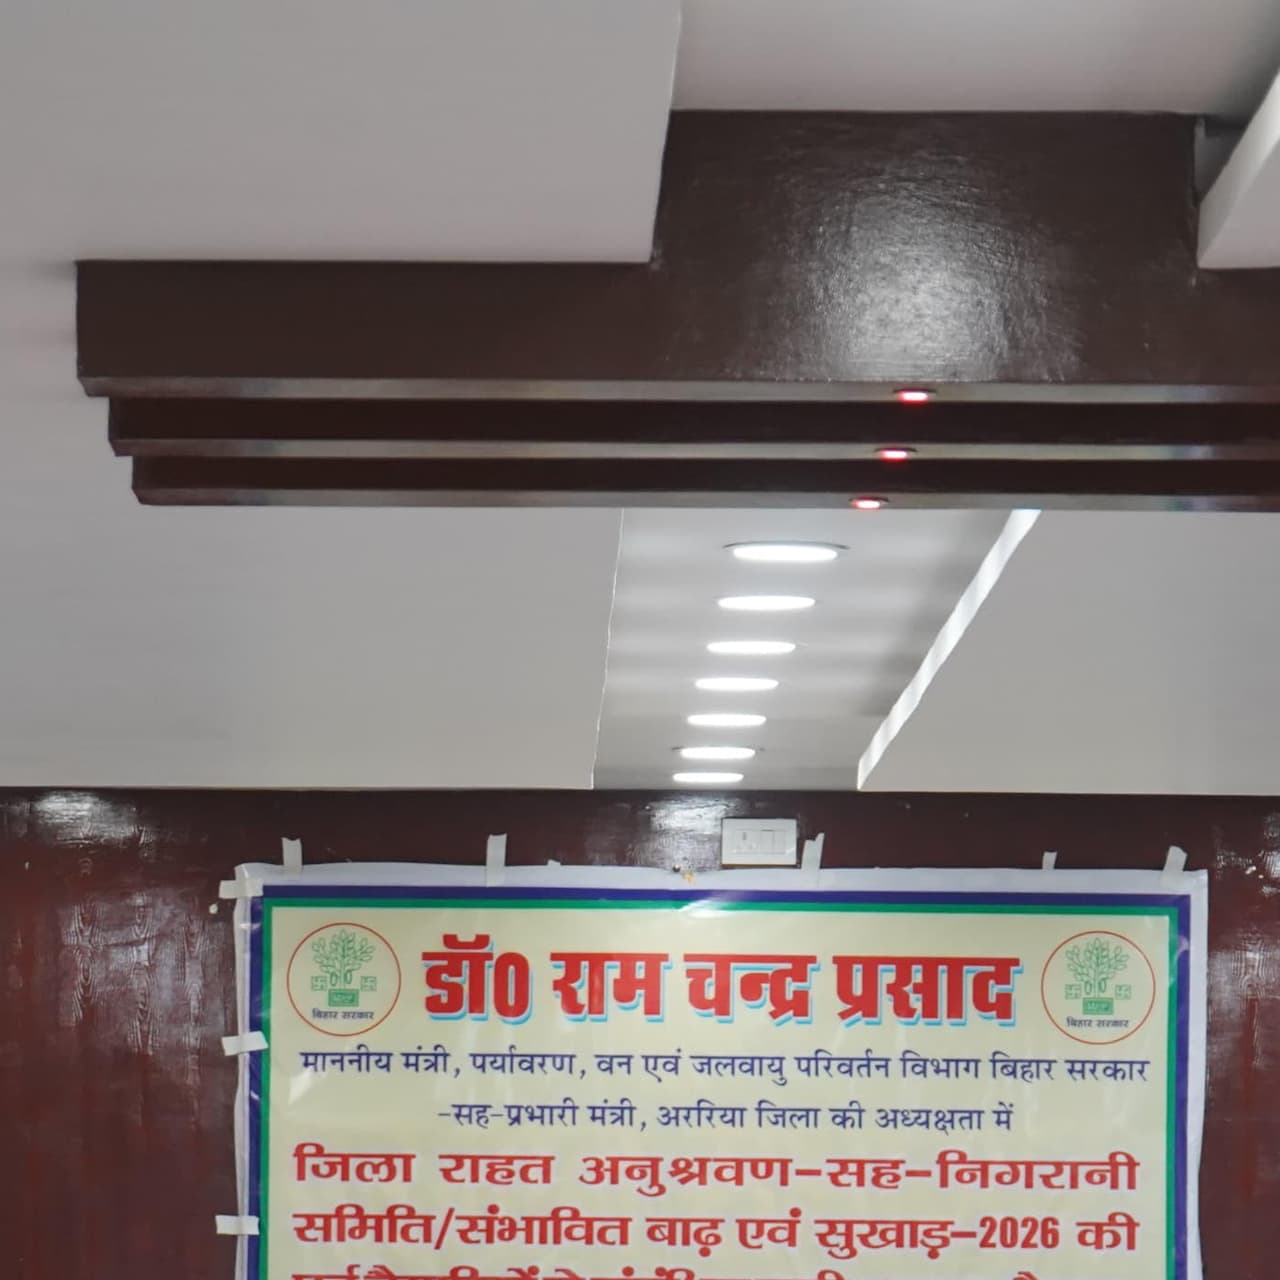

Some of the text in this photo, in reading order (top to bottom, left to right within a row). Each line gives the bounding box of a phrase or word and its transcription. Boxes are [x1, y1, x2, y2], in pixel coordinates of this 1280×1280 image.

[550, 952, 668, 1015] राम
[684, 954, 817, 1018] चन्द्र
[832, 955, 1020, 1019] प्रसाद
[300, 1044, 1150, 1086] माननीय मंत्री, पर्यावरण, वन एवं जलवायु परिवर्तन विभाग बिहार सरकार
[587, 1098, 647, 1131] मंत्री,
[658, 1099, 747, 1127] अररिया
[755, 1100, 821, 1128] जिला
[829, 1101, 865, 1128] की
[876, 1109, 984, 1134] अध्यक्षता
[992, 1102, 1013, 1130] में
[294, 1143, 415, 1182] जिला
[440, 1155, 553, 1184] राहत
[294, 1204, 1138, 1259] समिति/संभावित बाढ़ एवं सुखाड़-2026 की
